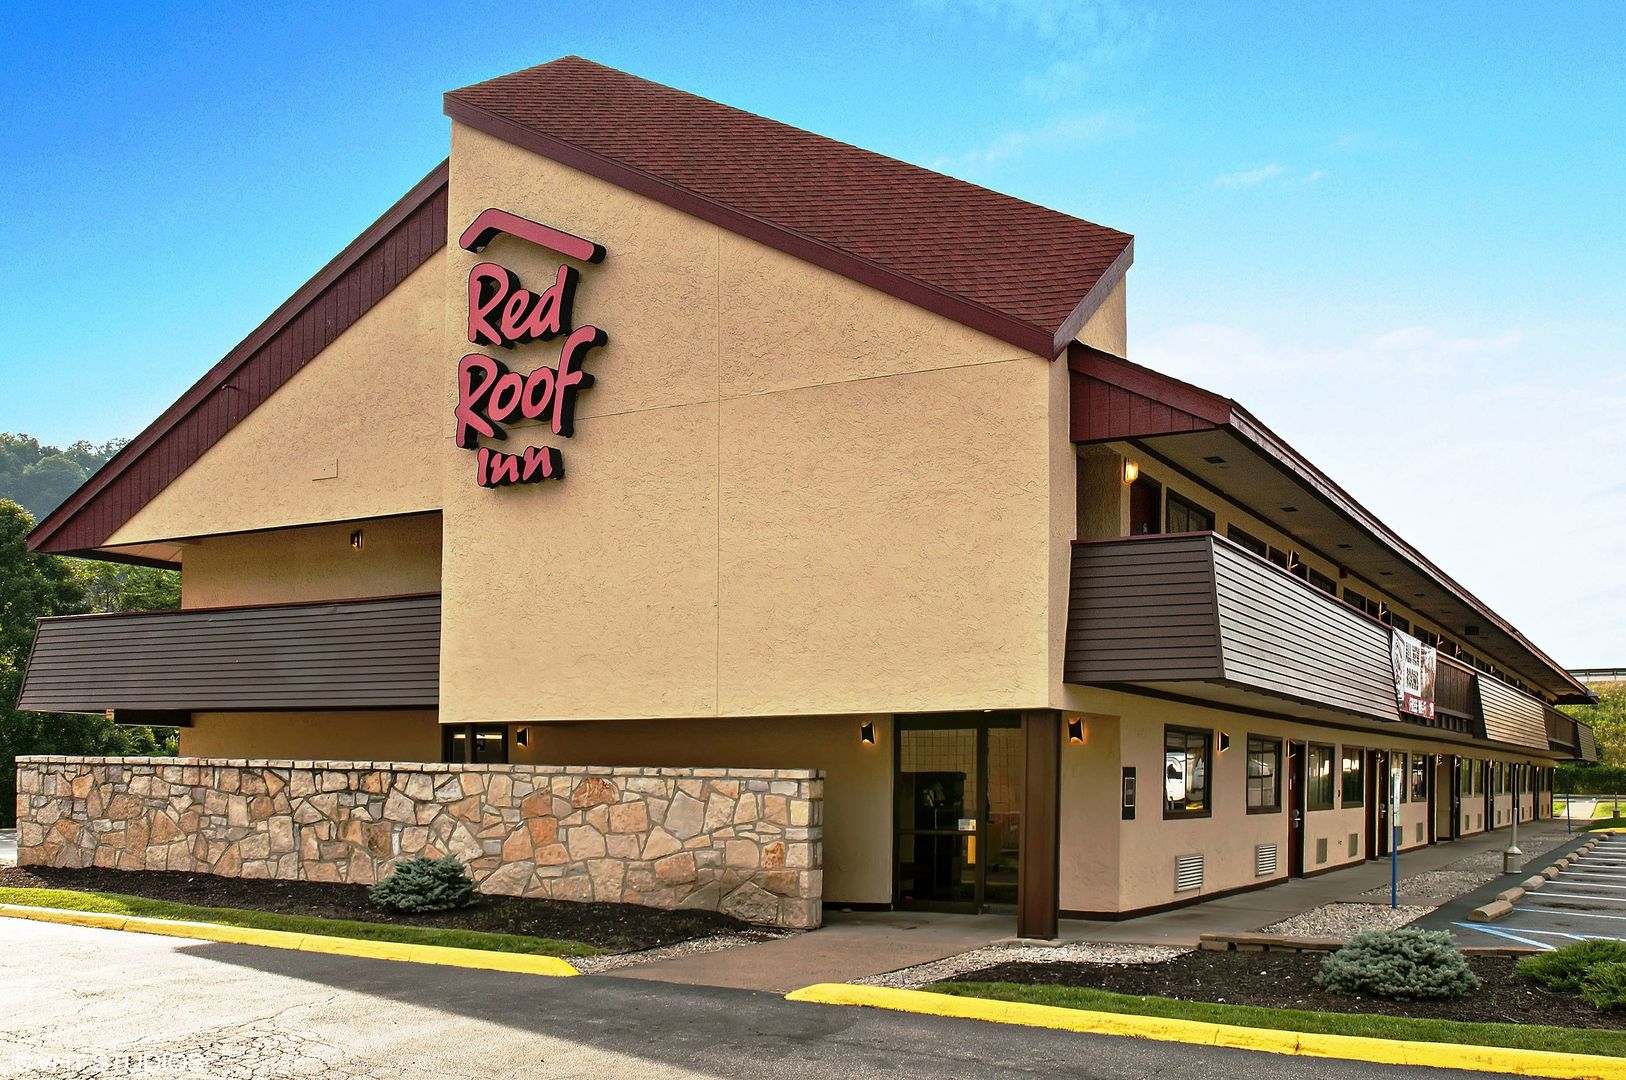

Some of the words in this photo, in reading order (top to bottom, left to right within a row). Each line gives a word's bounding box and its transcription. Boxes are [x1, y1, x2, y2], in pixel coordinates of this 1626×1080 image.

[468, 262, 578, 348] Red
[455, 325, 608, 449] Roof
[477, 446, 565, 488] Inn
